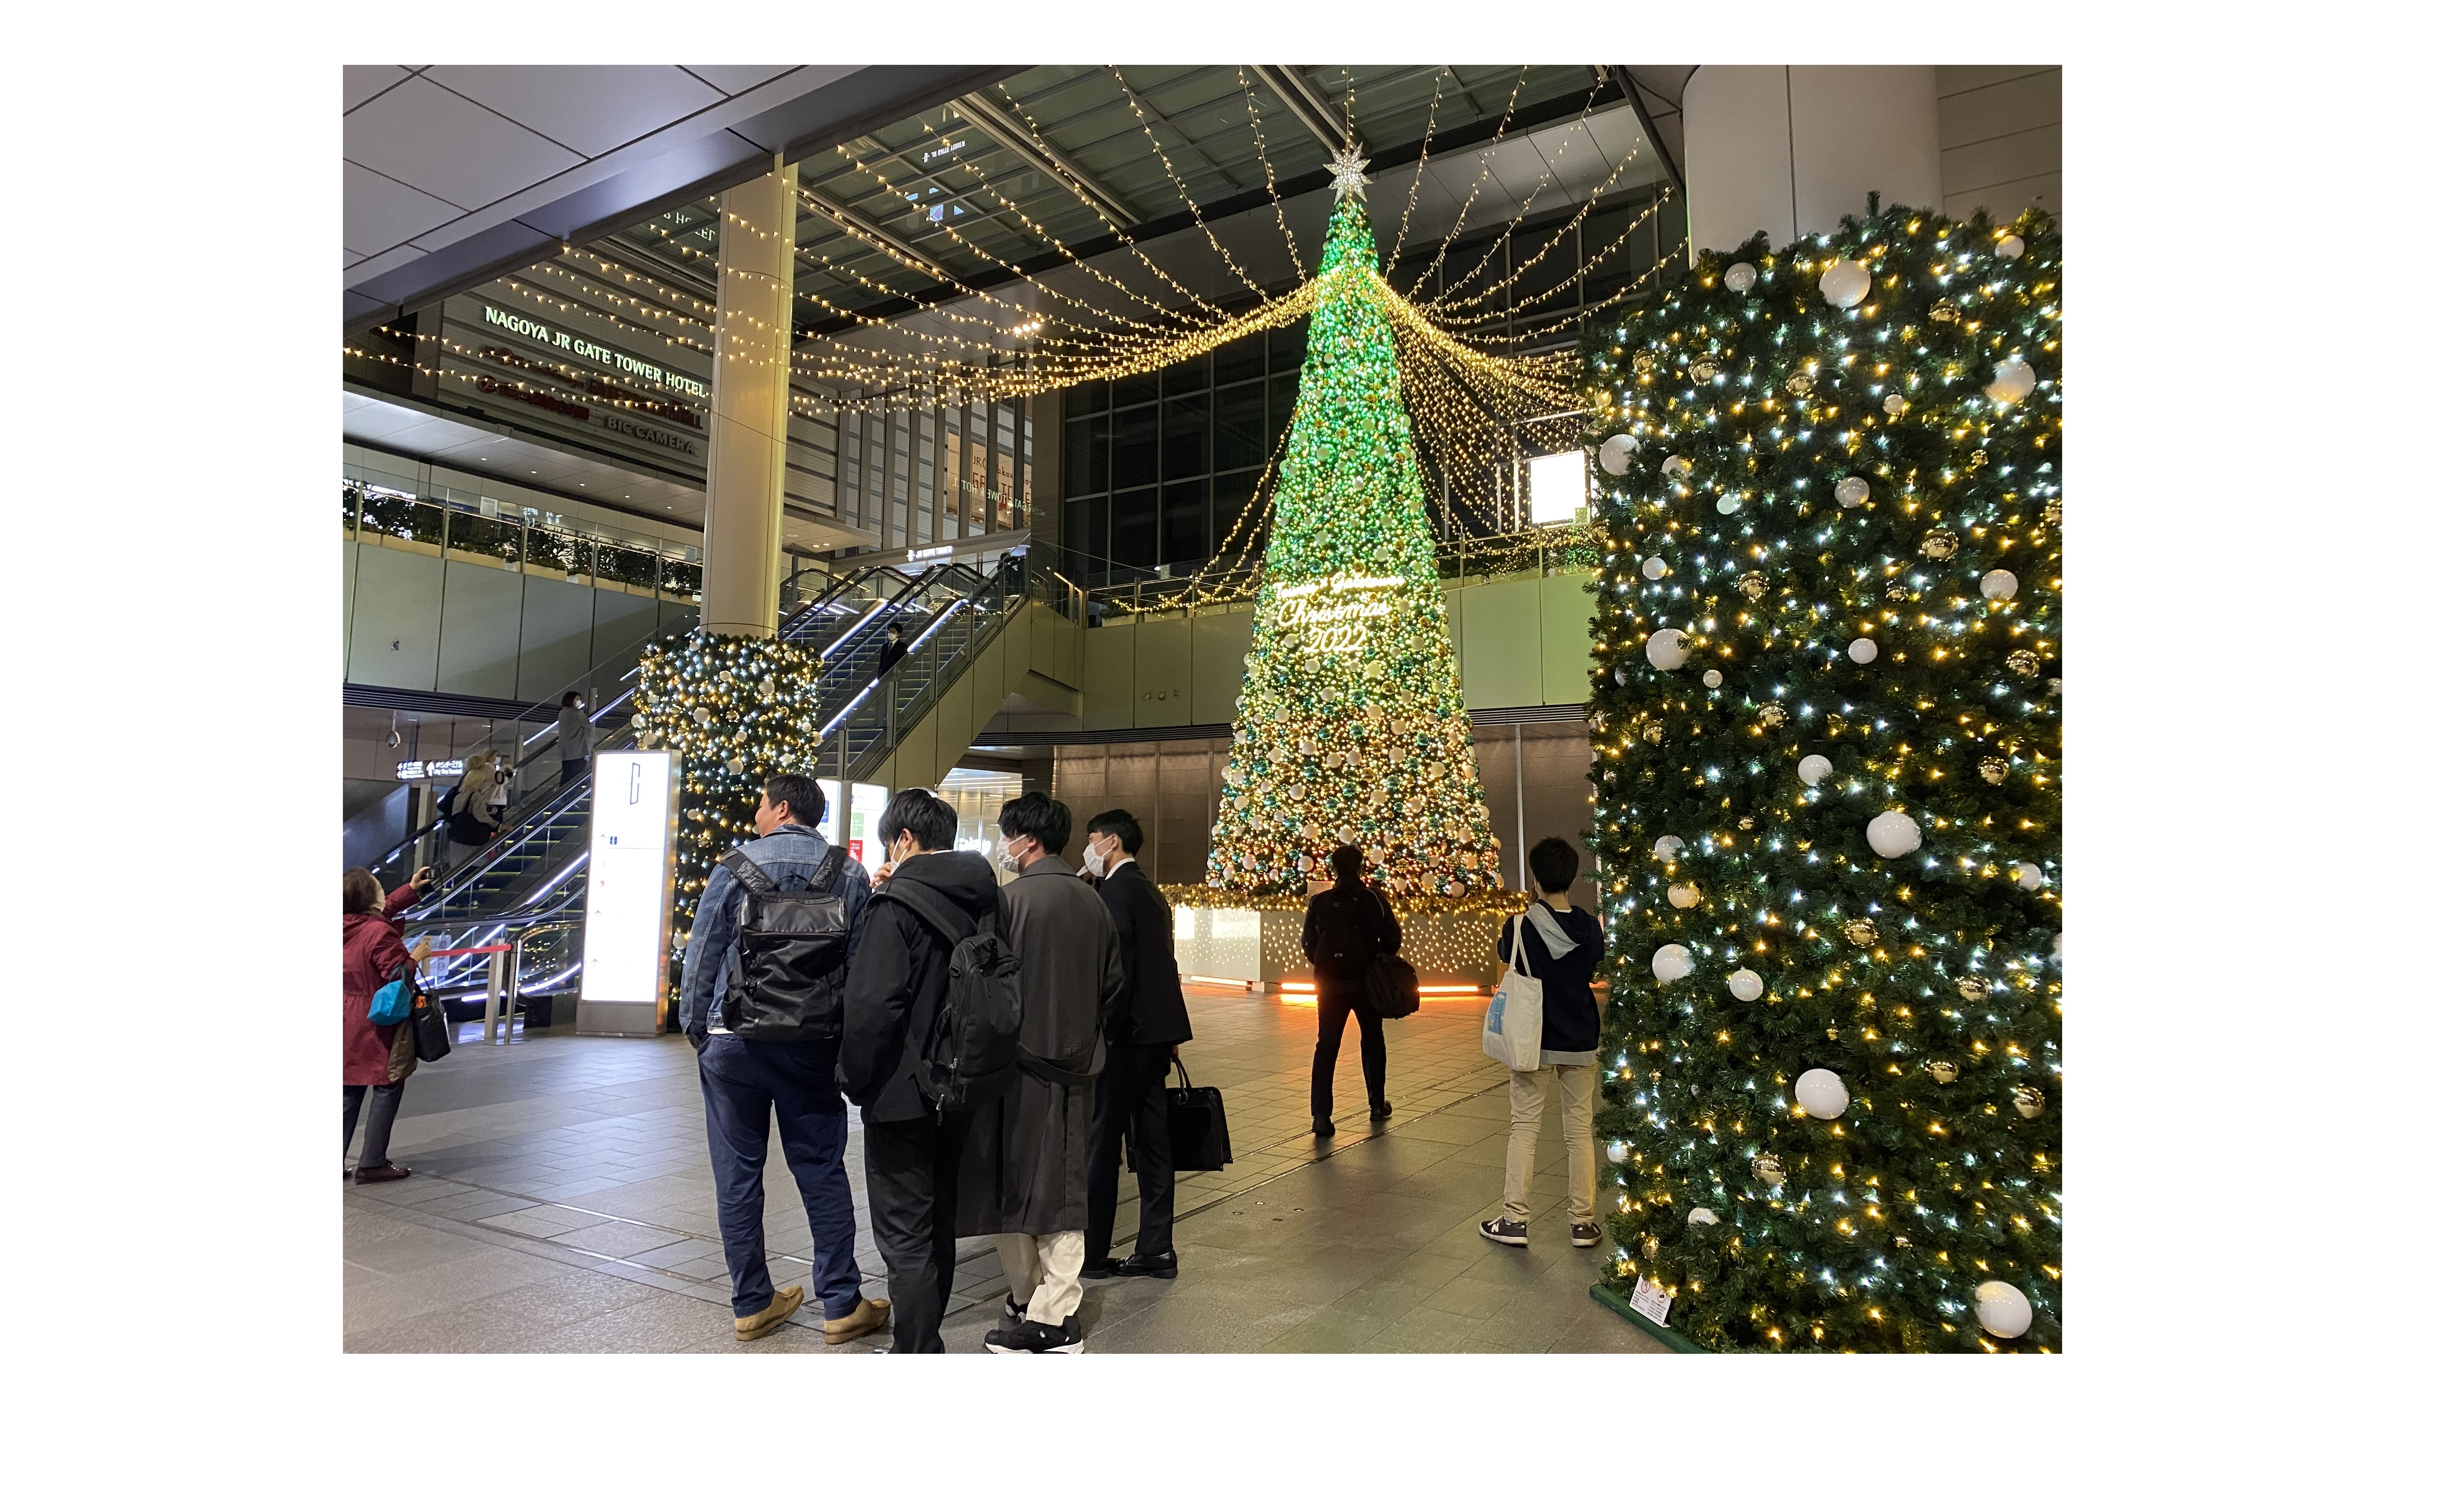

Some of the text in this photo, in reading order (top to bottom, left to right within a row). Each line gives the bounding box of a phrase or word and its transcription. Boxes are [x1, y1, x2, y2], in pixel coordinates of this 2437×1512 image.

[485, 306, 548, 342] NAGOYA
[552, 332, 570, 350] JR
[574, 340, 610, 364] GATE
[615, 353, 661, 382] TOWER
[666, 372, 705, 398] HOTEL
[608, 416, 695, 454] BIC CAMERA
[1278, 599, 1393, 626] Christmas
[1304, 625, 1366, 652] 2022
